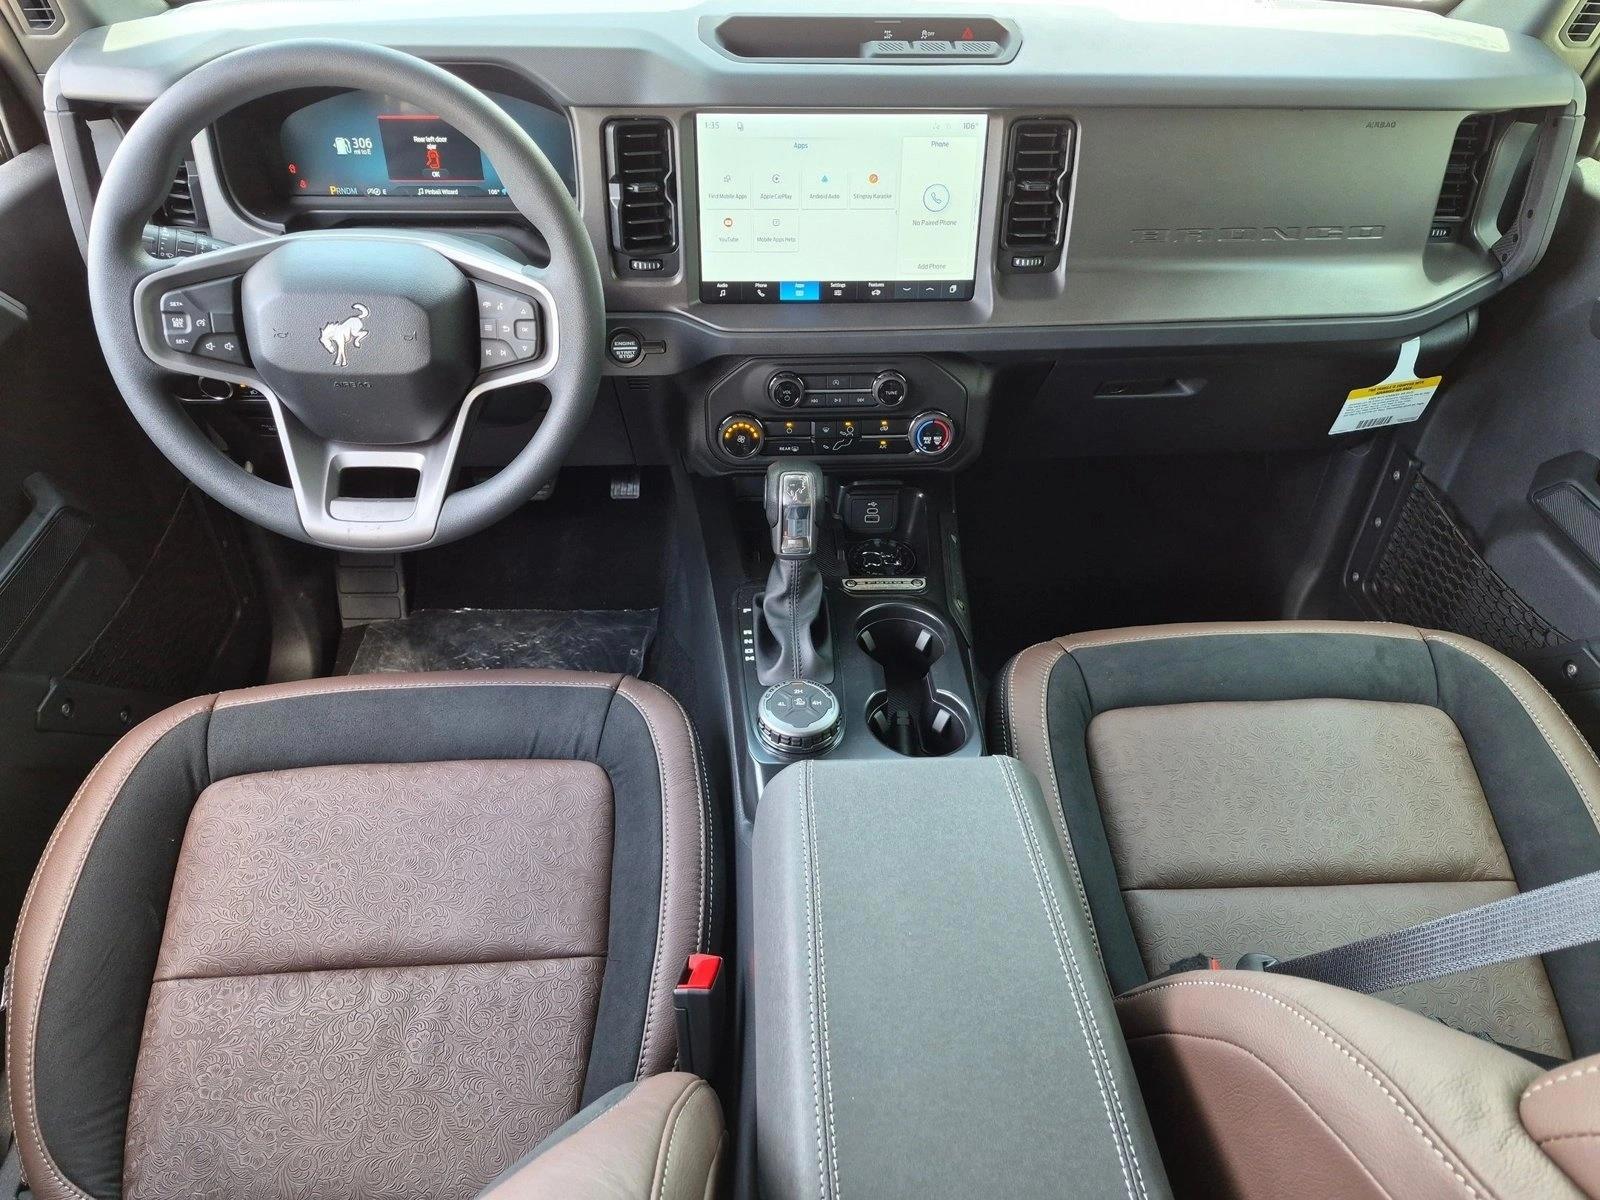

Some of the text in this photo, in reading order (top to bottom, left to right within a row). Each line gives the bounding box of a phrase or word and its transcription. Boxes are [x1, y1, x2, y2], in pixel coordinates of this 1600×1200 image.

[704, 120, 720, 130] 1:35
[351, 137, 373, 149] 306
[793, 141, 808, 150] Apps
[931, 139, 949, 148] Phone
[912, 218, 957, 226] No Paired Phone
[1129, 225, 1386, 243] BRONCO
[917, 262, 946, 270] Add Phone
